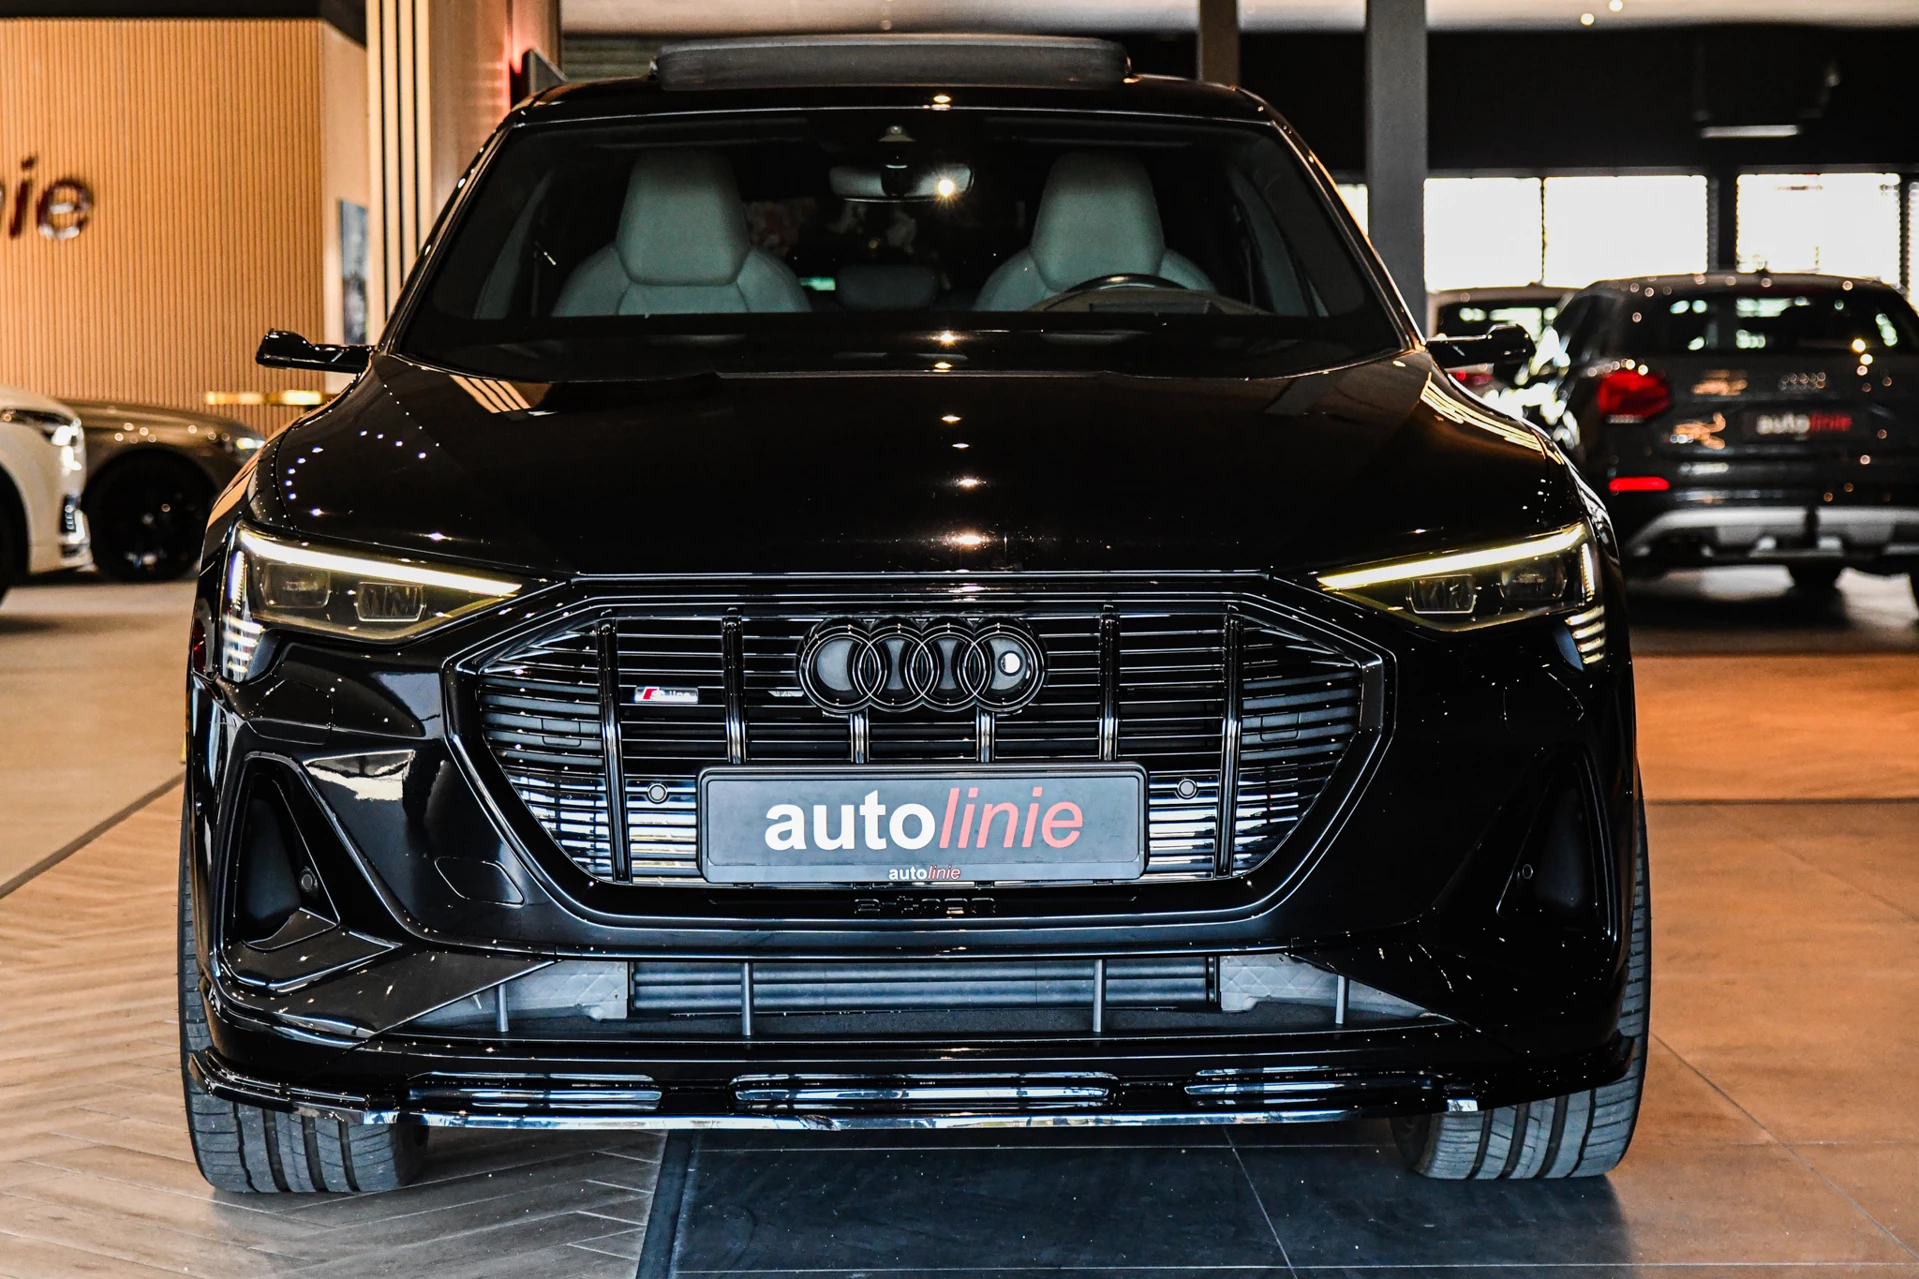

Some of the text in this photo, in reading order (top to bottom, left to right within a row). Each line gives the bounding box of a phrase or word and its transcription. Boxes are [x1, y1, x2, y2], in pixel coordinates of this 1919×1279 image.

[0, 156, 94, 240] ie
[764, 786, 1084, 851] autolinie
[888, 865, 961, 880] autolinie
